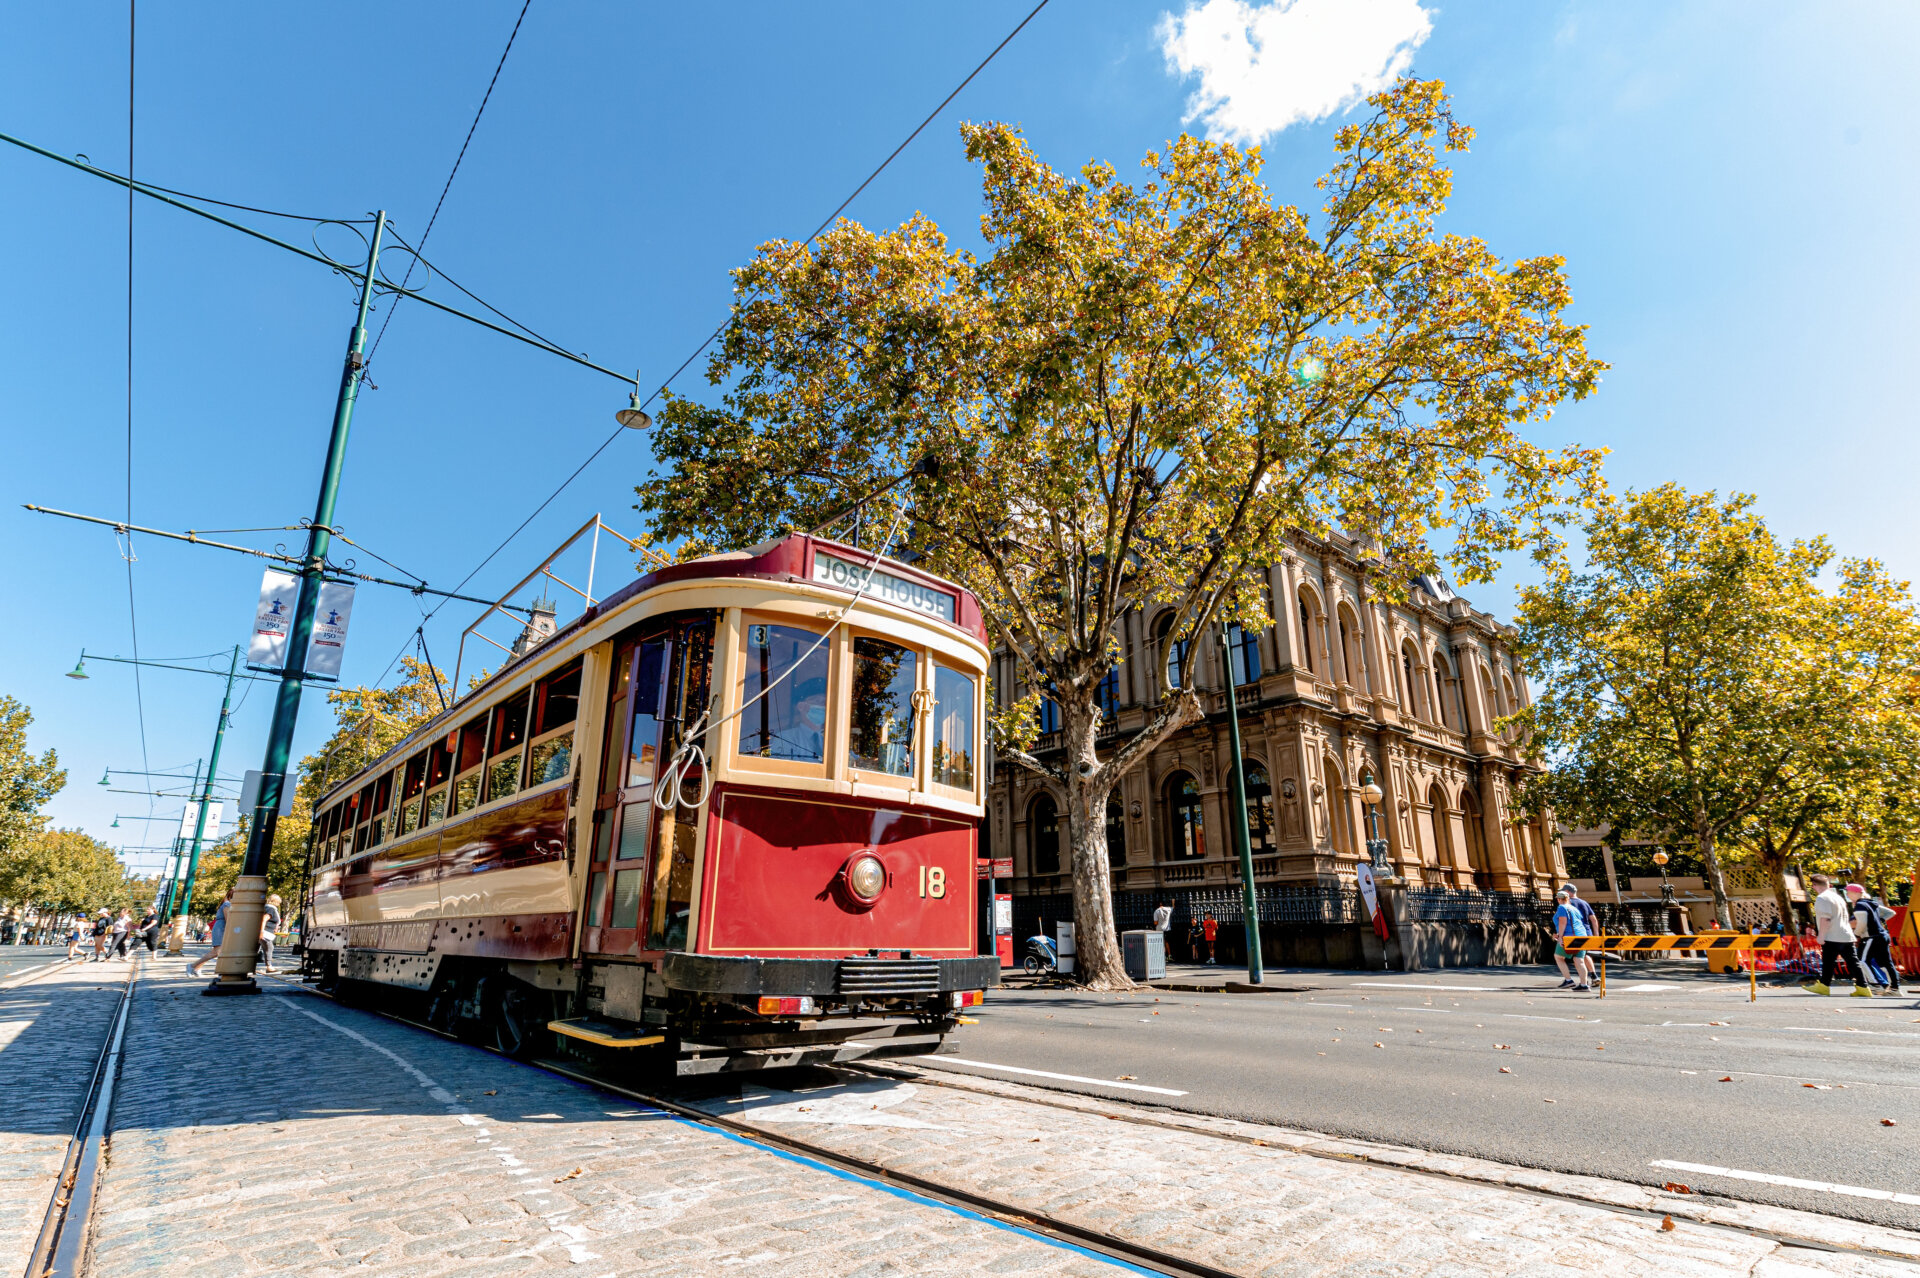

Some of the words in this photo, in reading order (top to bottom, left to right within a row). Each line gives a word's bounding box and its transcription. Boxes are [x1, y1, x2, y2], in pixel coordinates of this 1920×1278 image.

[821, 558, 872, 592] JOSS
[882, 574, 945, 615] HOUSE
[266, 621, 280, 629] 150
[323, 632, 336, 640] 150
[755, 628, 765, 643] 3
[919, 865, 947, 900] 18
